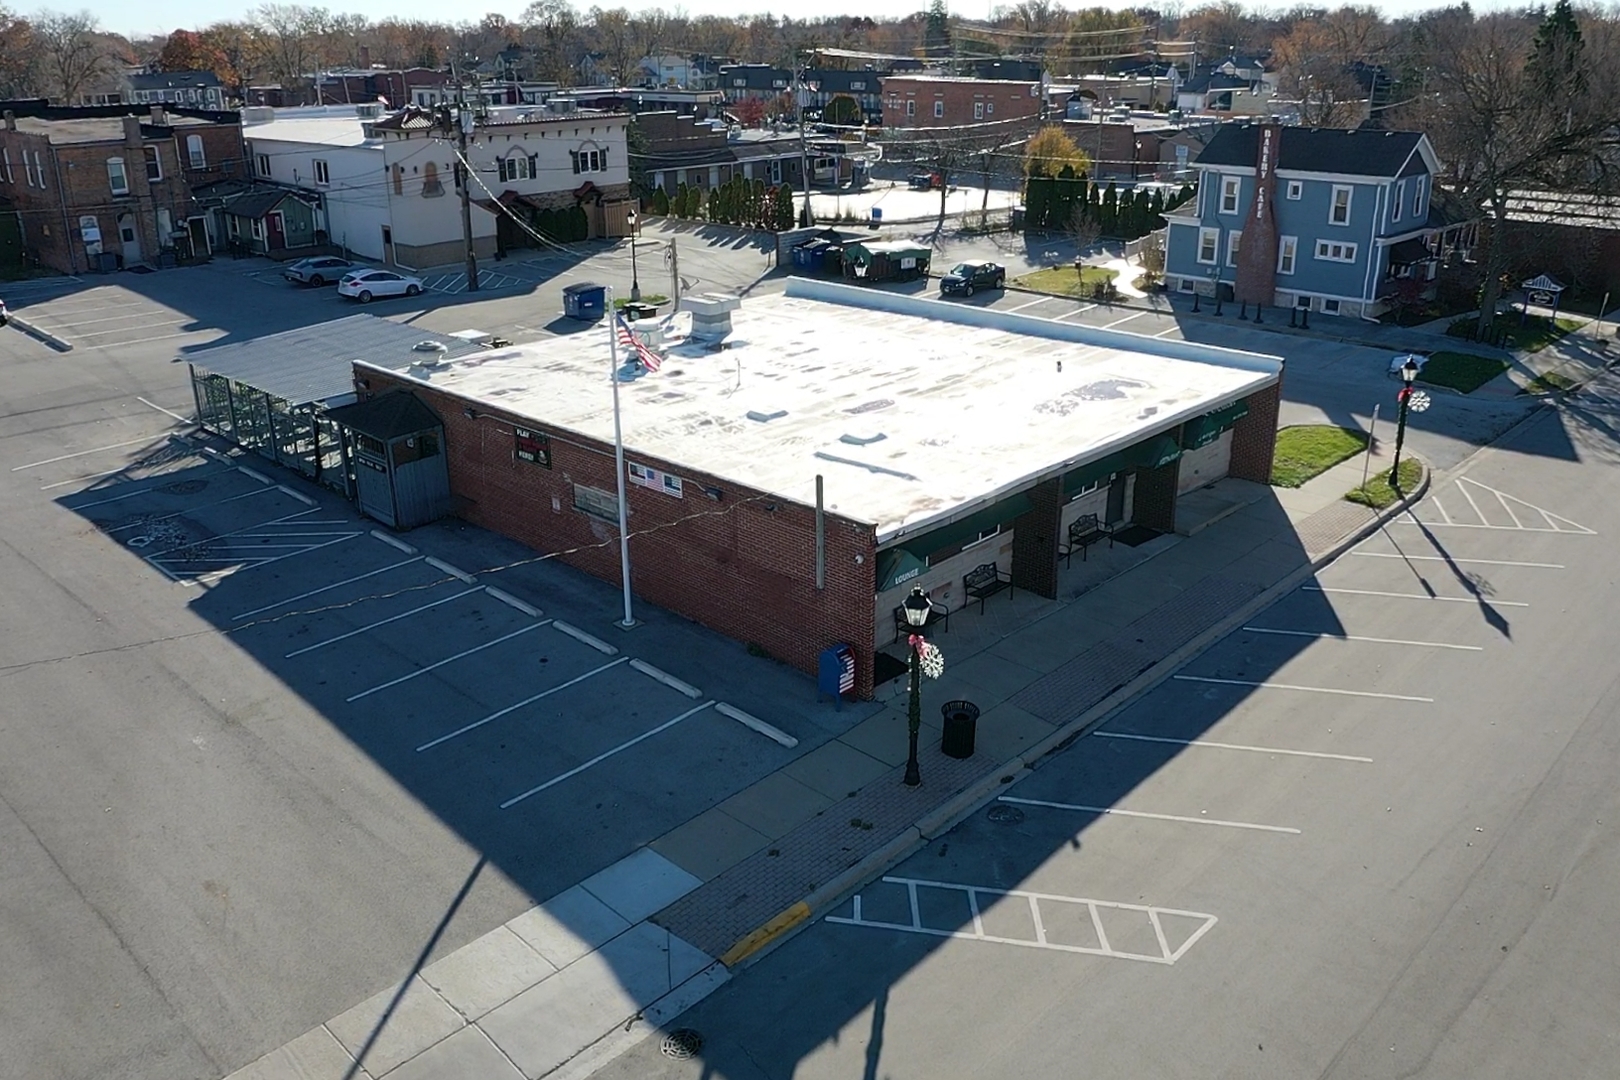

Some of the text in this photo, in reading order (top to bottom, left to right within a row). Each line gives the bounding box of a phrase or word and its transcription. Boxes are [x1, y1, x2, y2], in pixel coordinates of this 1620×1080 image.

[1261, 129, 1271, 179] BAKERY
[516, 428, 530, 438] PLAY
[895, 567, 919, 585] LOUNGE
